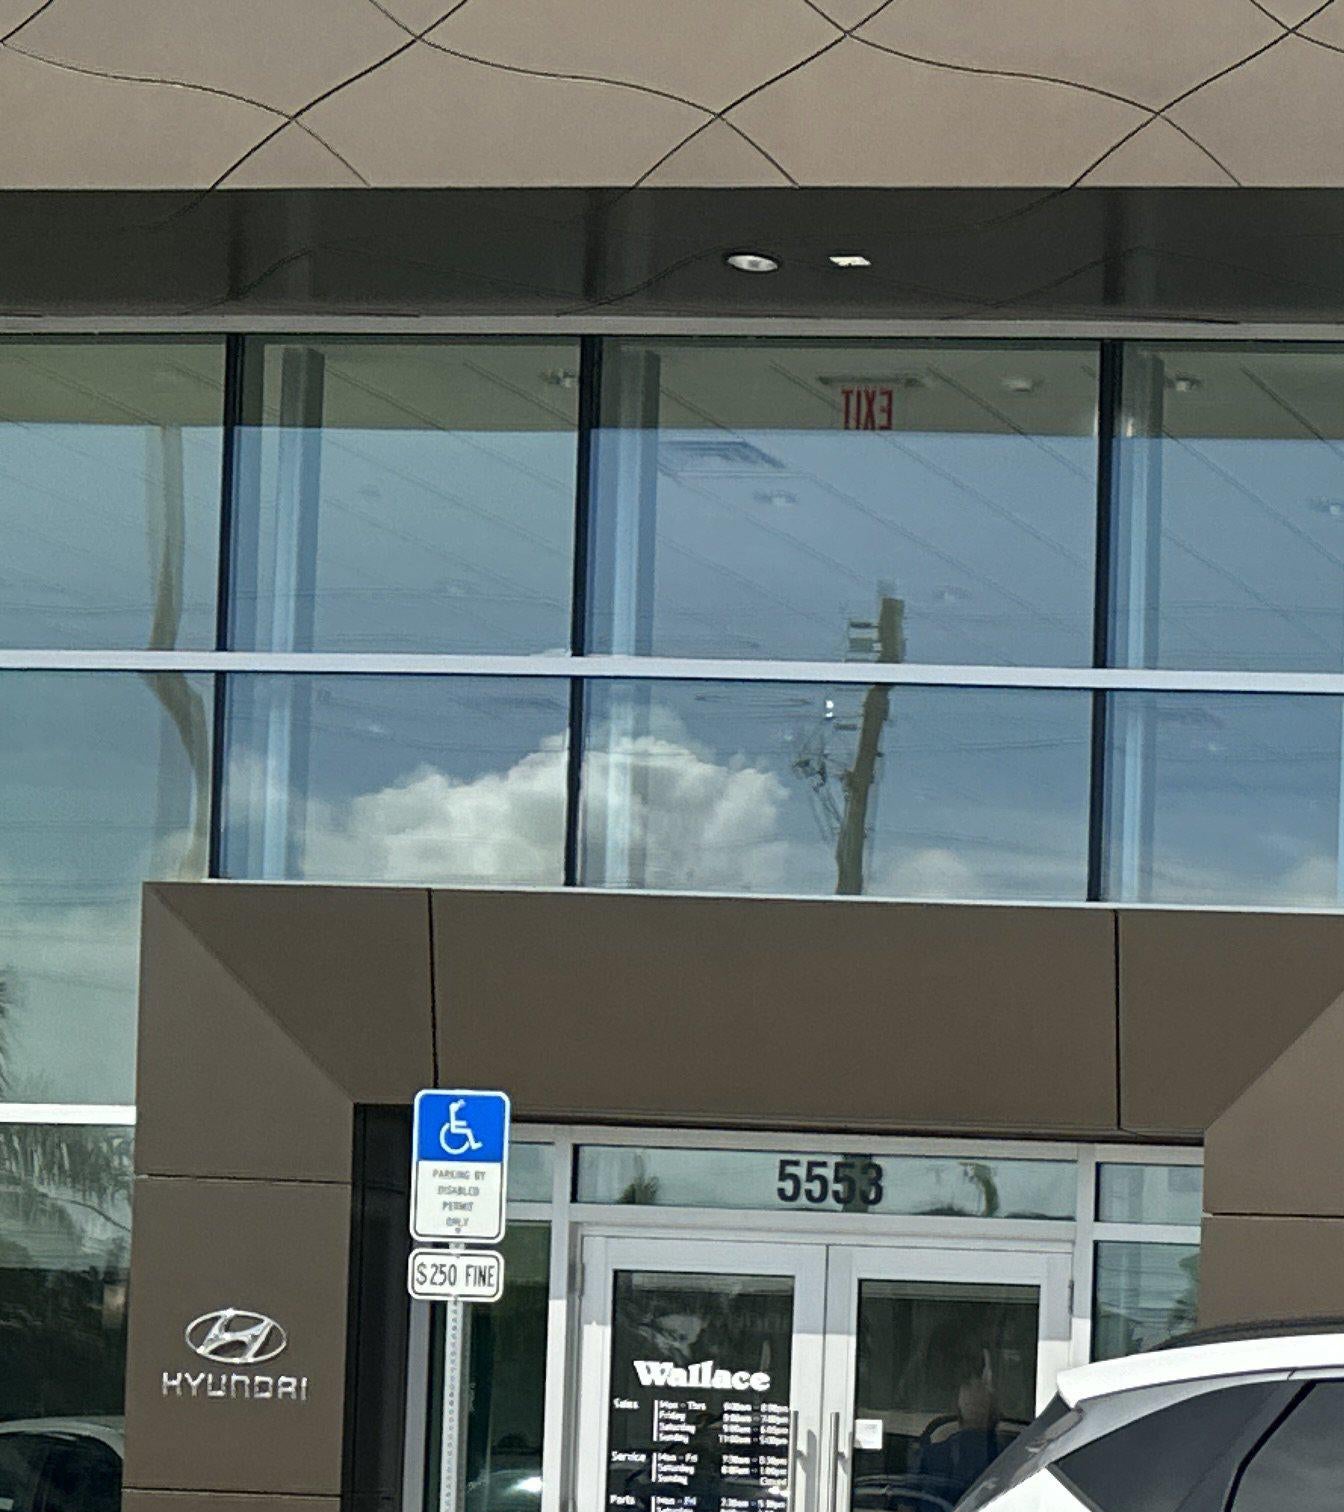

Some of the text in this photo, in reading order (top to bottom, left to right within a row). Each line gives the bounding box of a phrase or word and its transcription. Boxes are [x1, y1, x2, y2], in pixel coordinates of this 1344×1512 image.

[432, 1169, 486, 1181] PARKING BY
[777, 1159, 883, 1206] 5553
[437, 1186, 480, 1197] DISABLED
[416, 1261, 496, 1288] $250 FINE
[162, 1372, 308, 1400] HYUNDAI
[633, 1360, 771, 1391] Wallace
